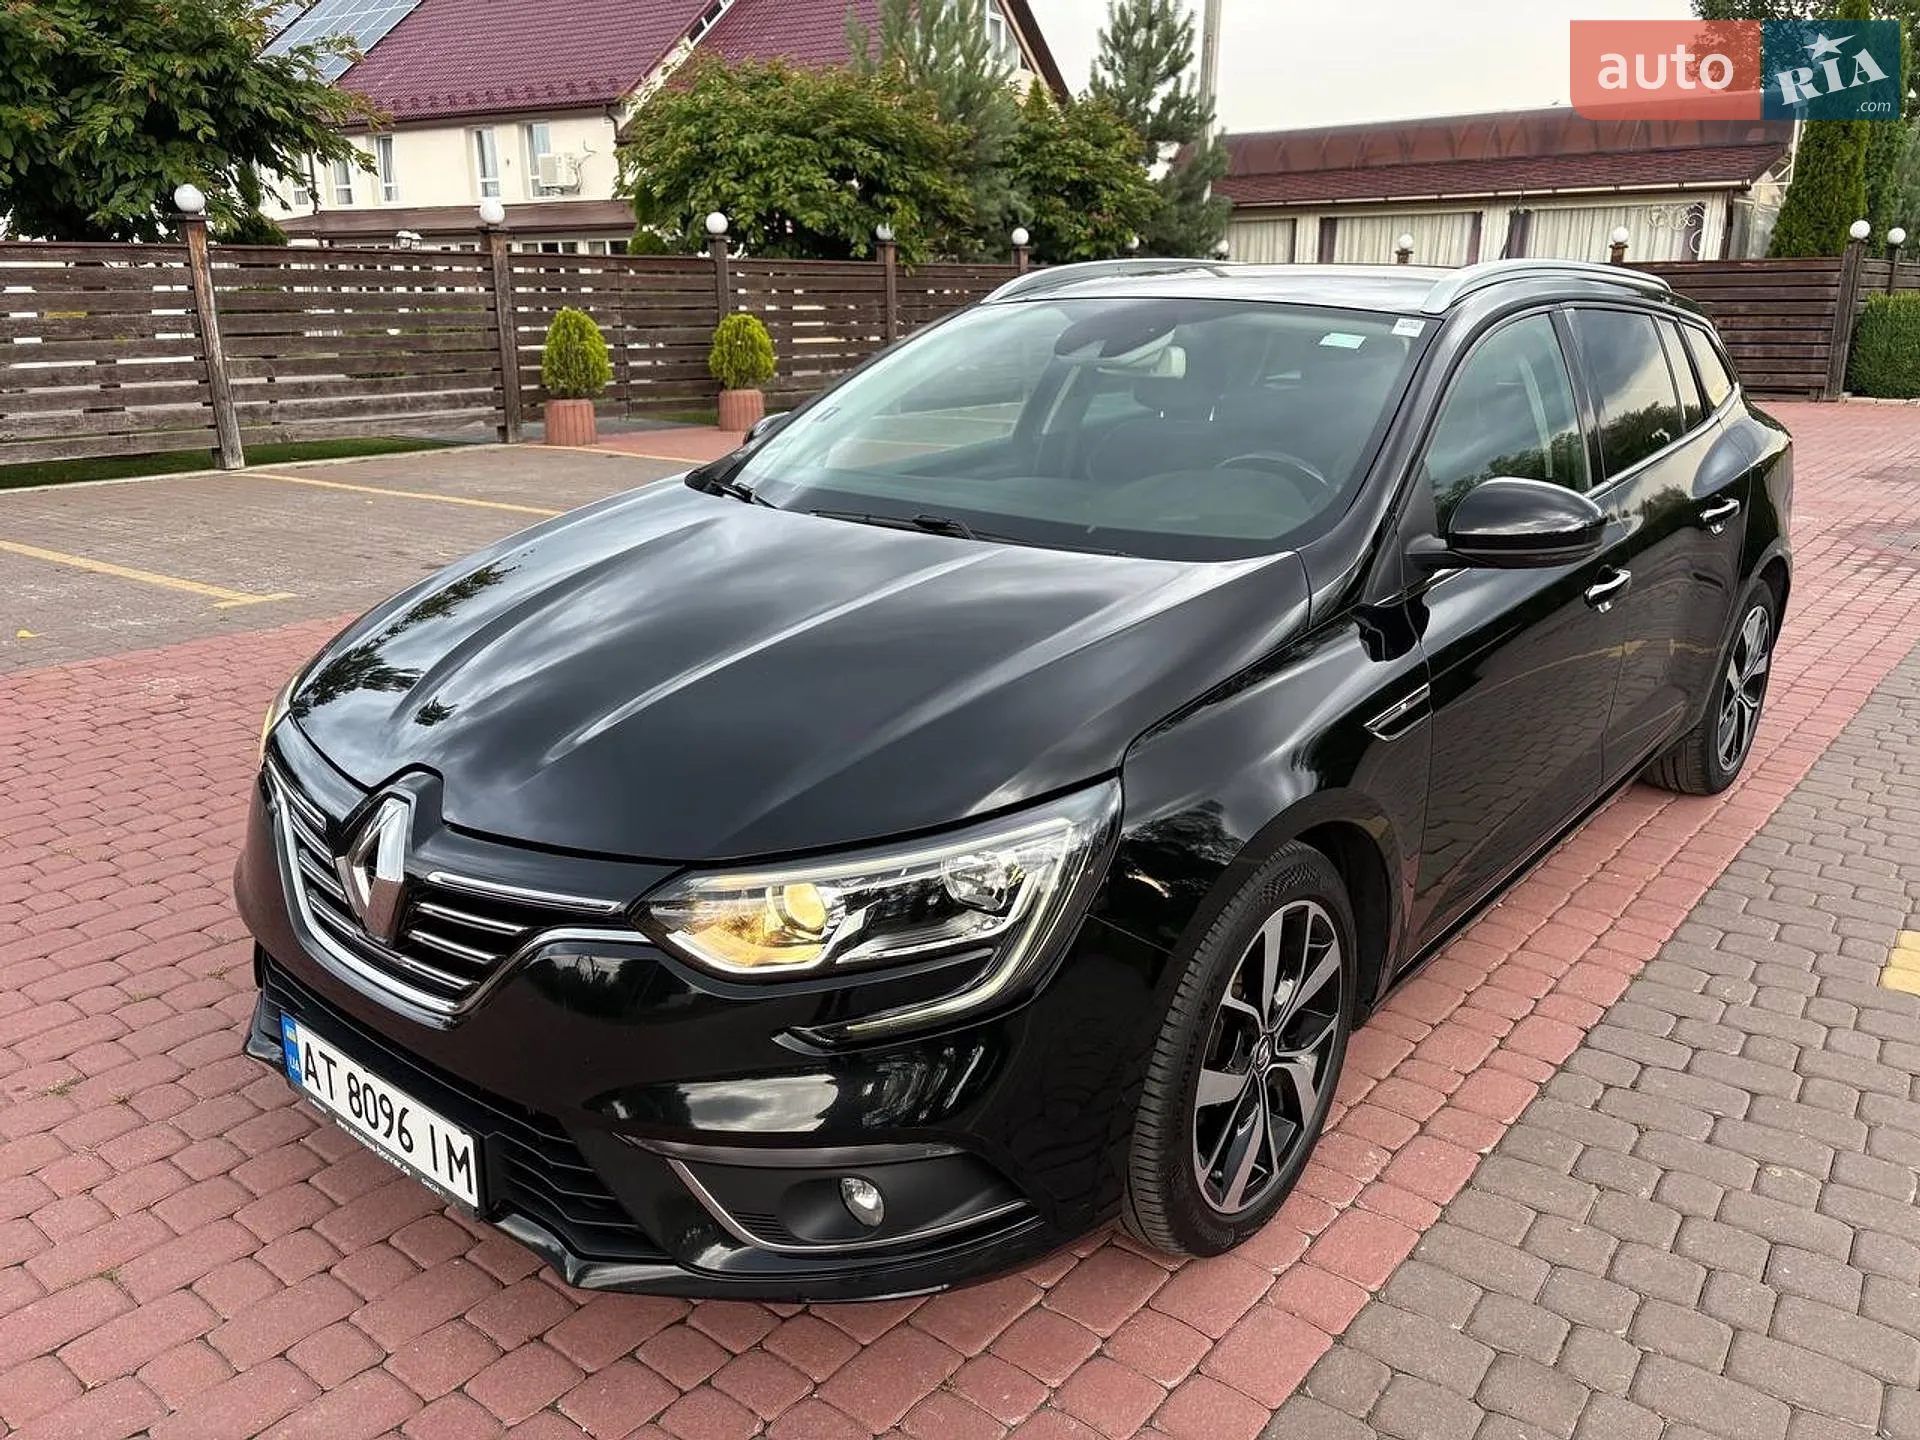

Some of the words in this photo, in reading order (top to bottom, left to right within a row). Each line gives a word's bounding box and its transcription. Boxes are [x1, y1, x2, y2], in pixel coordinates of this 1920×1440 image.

[304, 1041, 337, 1101] AT
[347, 1072, 414, 1154] 8096
[430, 1123, 474, 1194] IM
